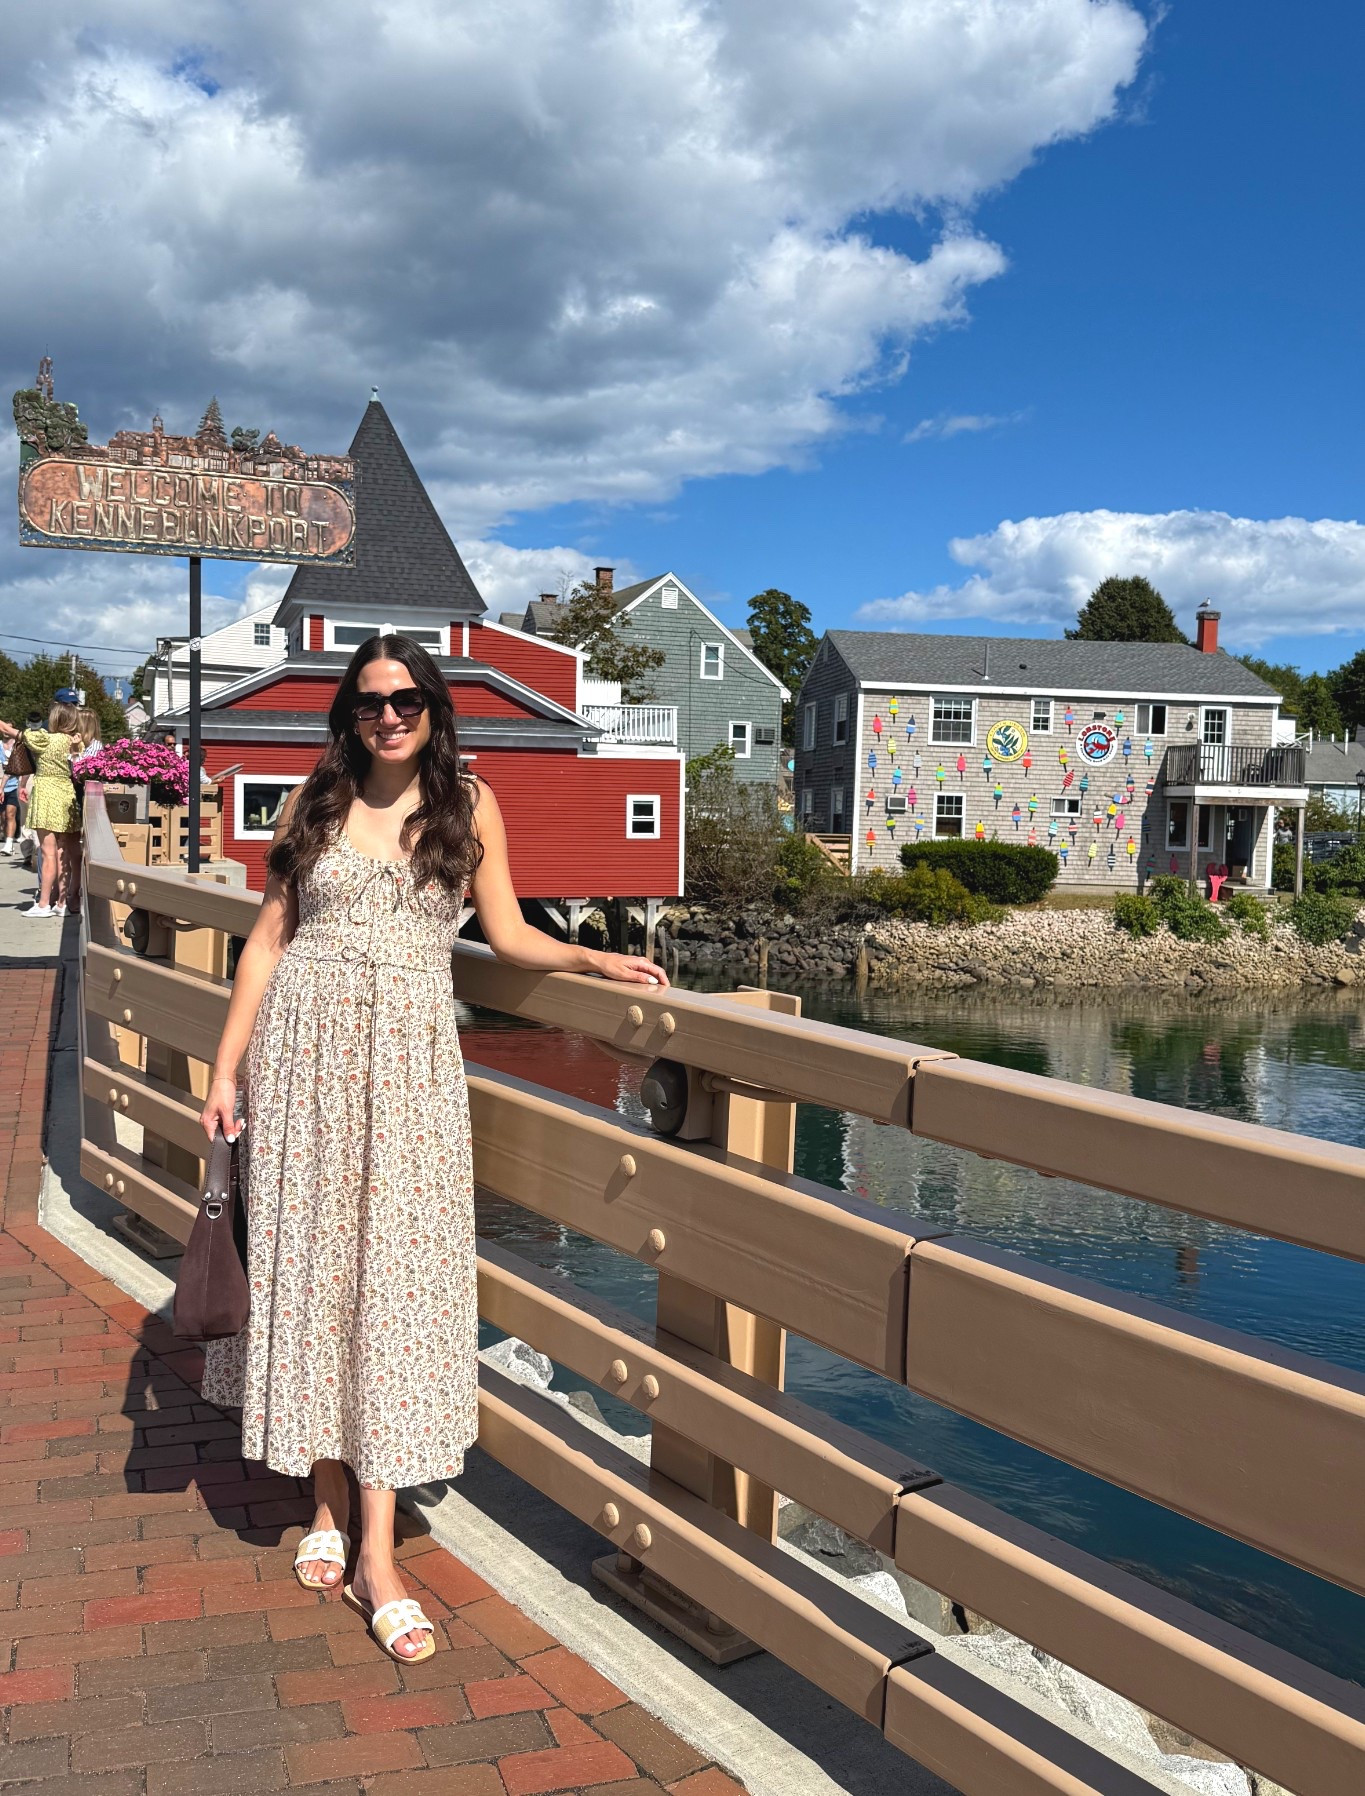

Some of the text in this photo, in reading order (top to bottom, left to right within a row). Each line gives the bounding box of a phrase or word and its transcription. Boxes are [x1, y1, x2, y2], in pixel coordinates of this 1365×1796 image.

[76, 464, 302, 517] WELCOME TO
[50, 498, 330, 554] KENNEBUNKPORT
